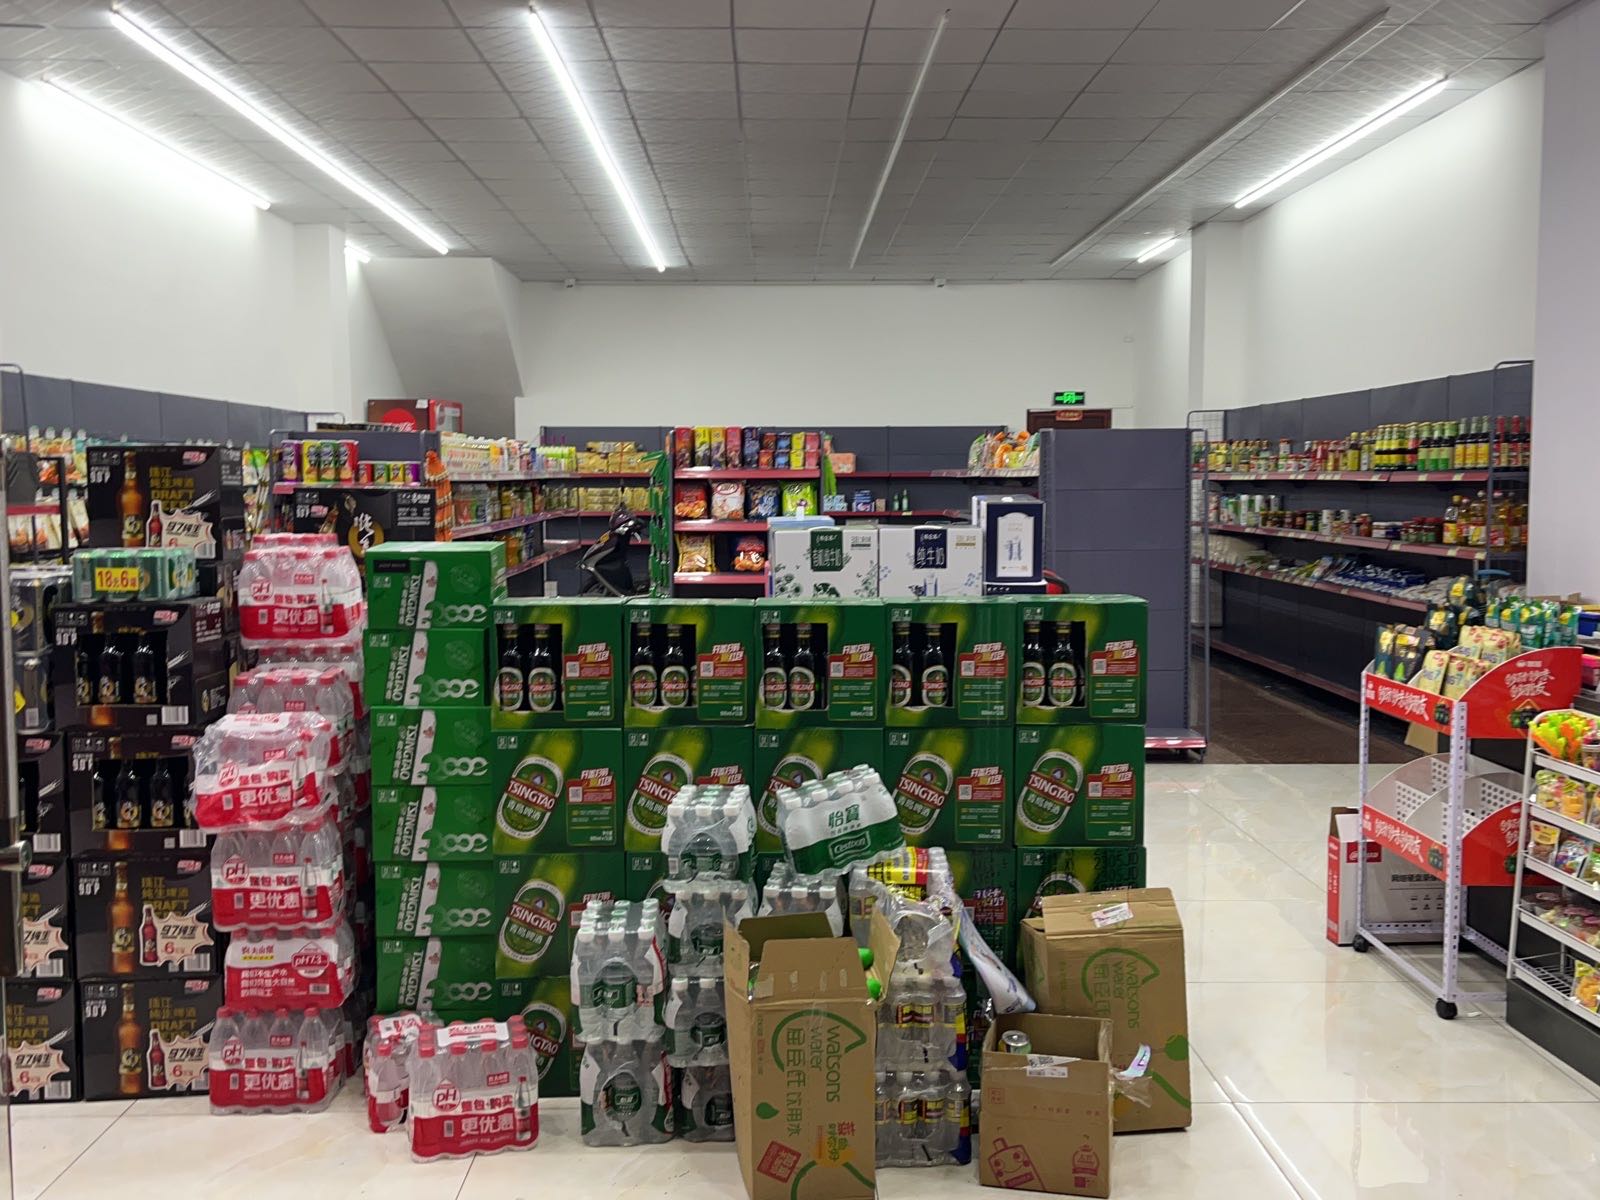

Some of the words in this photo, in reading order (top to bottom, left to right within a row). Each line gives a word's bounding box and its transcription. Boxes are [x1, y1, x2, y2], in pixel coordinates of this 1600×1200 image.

[273, 608, 319, 625] 更优惠
[405, 573, 421, 626] TSINGTAO
[392, 644, 411, 701] TSINGTAO
[400, 724, 418, 780] TSINGTAO
[239, 787, 291, 809] 更优惠
[508, 780, 555, 809] TSINGTAO
[638, 777, 676, 803] TSINGT
[898, 777, 945, 806] TSINGTAO
[1028, 774, 1075, 803] TSINGTAO
[400, 800, 419, 856] TSINGTAO
[250, 892, 300, 909] 更优惠
[404, 875, 422, 932] TSINGTAO
[510, 905, 557, 933] TSINGTAO
[405, 950, 424, 1006] TSINGTAO
[1126, 961, 1140, 1031] watsons
[786, 1027, 807, 1088] 屈臣氏
[810, 1026, 823, 1072] water
[826, 1025, 841, 1103] watsons
[244, 1073, 294, 1091] 更优惠
[461, 1113, 514, 1137] 更优惠
